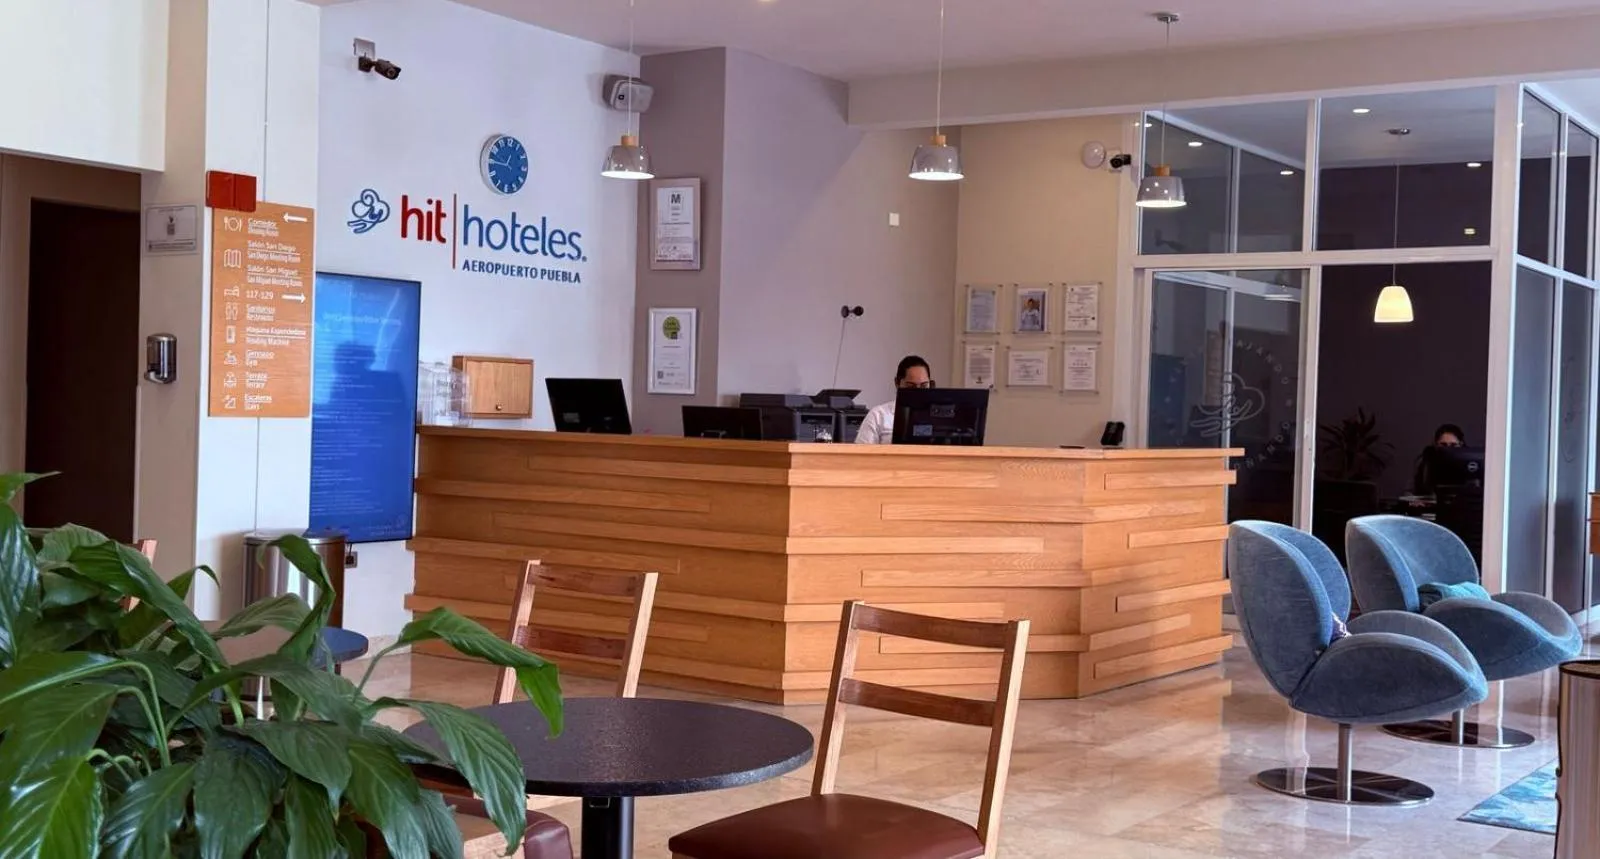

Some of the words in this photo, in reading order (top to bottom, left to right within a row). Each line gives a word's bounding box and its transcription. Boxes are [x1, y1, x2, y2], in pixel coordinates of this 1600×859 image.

[401, 194, 447, 244] hit
[462, 259, 538, 279] AEROPUERTO
[540, 268, 581, 283] PUEBLA
